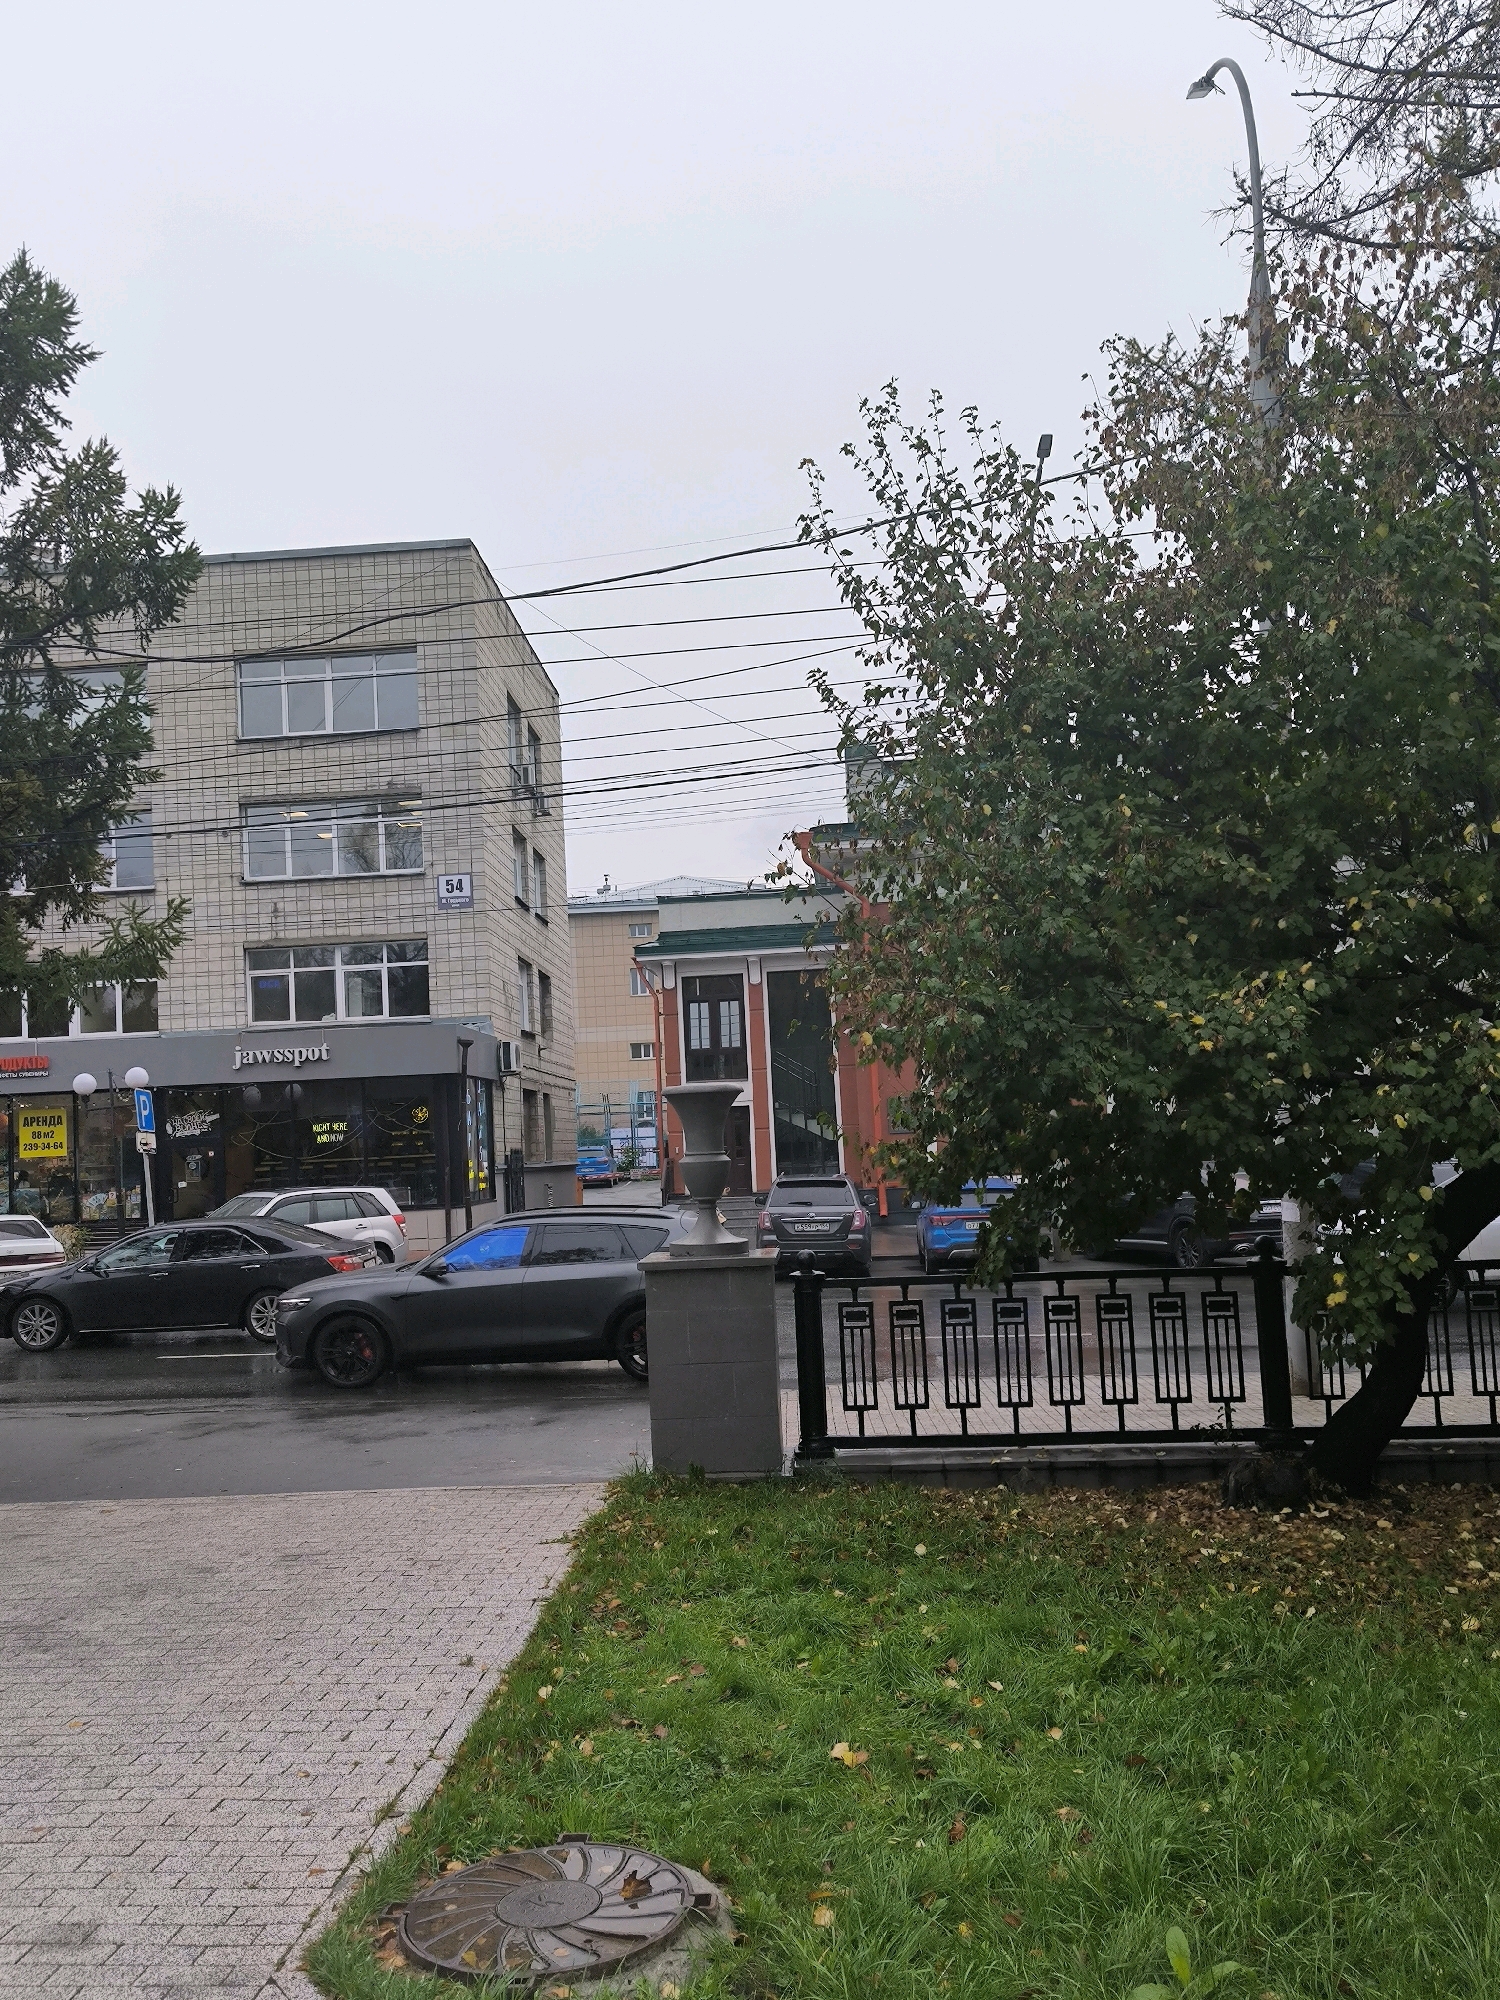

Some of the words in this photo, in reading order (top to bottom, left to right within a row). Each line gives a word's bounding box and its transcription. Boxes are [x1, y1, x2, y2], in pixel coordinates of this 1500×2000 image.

[445, 878, 464, 894] 54
[232, 1042, 330, 1070] jawsspot
[22, 1115, 63, 1128] АРЕНДА
[31, 1130, 42, 1140] 88
[23, 1141, 64, 1151] 239-34-64
